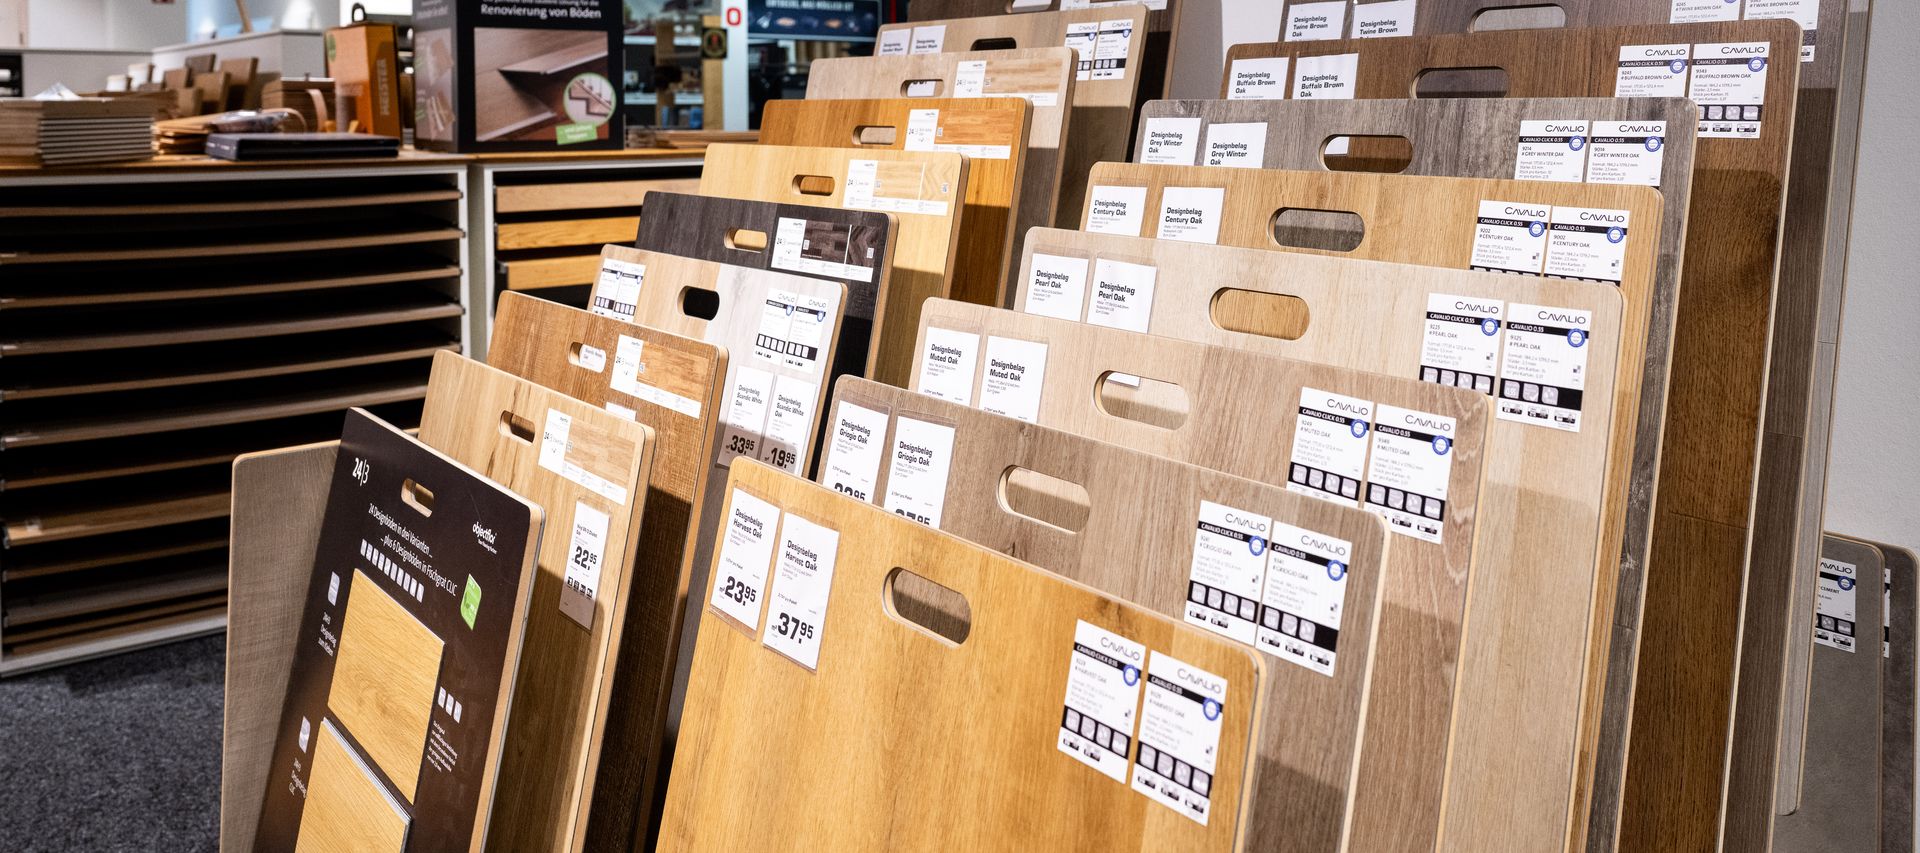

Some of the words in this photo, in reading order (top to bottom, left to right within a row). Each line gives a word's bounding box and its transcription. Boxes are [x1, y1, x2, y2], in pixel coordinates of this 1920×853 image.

[481, 4, 548, 20] Renovierung
[549, 8, 568, 17] von
[569, 6, 602, 19] Böden
[1294, 15, 1327, 24] Designbelag
[1360, 19, 1397, 28] Designbelag
[1378, 26, 1398, 34] Brown
[1645, 48, 1686, 57] CAVALIO
[1721, 46, 1765, 55] CAVALIO
[1237, 72, 1271, 80] Designbelag
[1302, 74, 1338, 82] Designbelag
[1151, 131, 1183, 140] Designbelag
[1545, 124, 1585, 133] CAVALIO
[1618, 125, 1661, 133] CAVALIO
[1149, 139, 1162, 147] Grey
[1212, 142, 1247, 151] Designbelag
[1094, 199, 1127, 209] Designbelag
[1093, 208, 1115, 217] Century
[1166, 207, 1202, 217] Designbelag
[1504, 206, 1546, 218] CAVALIO
[1579, 212, 1625, 223] CAVALIO
[1165, 215, 1189, 225] Century
[1189, 216, 1203, 224] Oak
[1036, 269, 1069, 282] Designbelag
[1034, 278, 1049, 287] Pearl
[1050, 280, 1062, 289] Oak
[1099, 281, 1135, 296] Designbelag
[1098, 290, 1113, 301] Pearl
[1113, 293, 1126, 303] Oak
[1455, 301, 1499, 314] CAVALIO
[1538, 310, 1586, 325] CAVALIO
[1510, 323, 1532, 331] CAVALIO
[931, 343, 962, 358] Designbelag
[929, 352, 946, 363] Muted
[947, 355, 959, 365] Oak
[990, 359, 1025, 374] Designbelag
[989, 369, 1008, 379] Muted
[1009, 372, 1021, 382] Oak
[738, 384, 760, 397] Designbelag
[751, 396, 763, 405] White
[778, 394, 802, 408] Designbelag
[1326, 398, 1368, 416] CAVALIO
[776, 402, 792, 413] Scandic
[792, 407, 804, 417] White
[1302, 407, 1322, 418] CAVALIO
[1322, 412, 1336, 422] CLICK
[1335, 415, 1345, 424] 0.55
[841, 418, 871, 436] Designbelag
[1404, 414, 1451, 432] CAVALIO
[839, 428, 857, 441] Griogio
[857, 434, 868, 445] Oak
[1378, 425, 1400, 435] CAVALIO
[1400, 429, 1411, 438] 0.55
[730, 434, 755, 456] 33,95
[899, 441, 933, 458] Designbelag
[770, 447, 796, 470] 19,95
[897, 451, 918, 464] Griogio
[918, 456, 930, 467] Oak
[735, 507, 763, 530] Designbelag
[1225, 513, 1266, 532] CAVALIO
[374, 506, 398, 532] Designböden
[410, 530, 430, 555] Varianten
[472, 521, 496, 545] objectflor
[733, 518, 752, 535] Harvest
[752, 529, 763, 540] Oak
[1201, 522, 1221, 534] CAVALIO
[1220, 528, 1234, 538] CLICK
[1233, 531, 1244, 540] 0.55
[787, 539, 818, 562] Designbelag
[1222, 548, 1232, 556] OAK
[1274, 543, 1295, 557] CAVALIO
[1295, 550, 1306, 560] 0.55
[1300, 535, 1346, 556] CAVALIO
[383, 534, 393, 548] plus
[396, 540, 422, 571] Designböden
[447, 579, 458, 596] CLIC
[573, 545, 598, 572] 22,95
[785, 550, 804, 567] Harvest
[805, 561, 818, 572] Oak
[1820, 561, 1853, 575] AVALIO
[1298, 573, 1309, 581] OAK
[724, 575, 757, 606] 23,95
[1820, 585, 1840, 595] CEMENT
[777, 611, 814, 644] 37,95
[1076, 644, 1094, 661] CAVALIO
[1093, 651, 1108, 665] CLICK
[1100, 636, 1140, 662] CAVALIO
[1151, 676, 1172, 691] CAVALIO
[1177, 667, 1221, 695] CAVALIO
